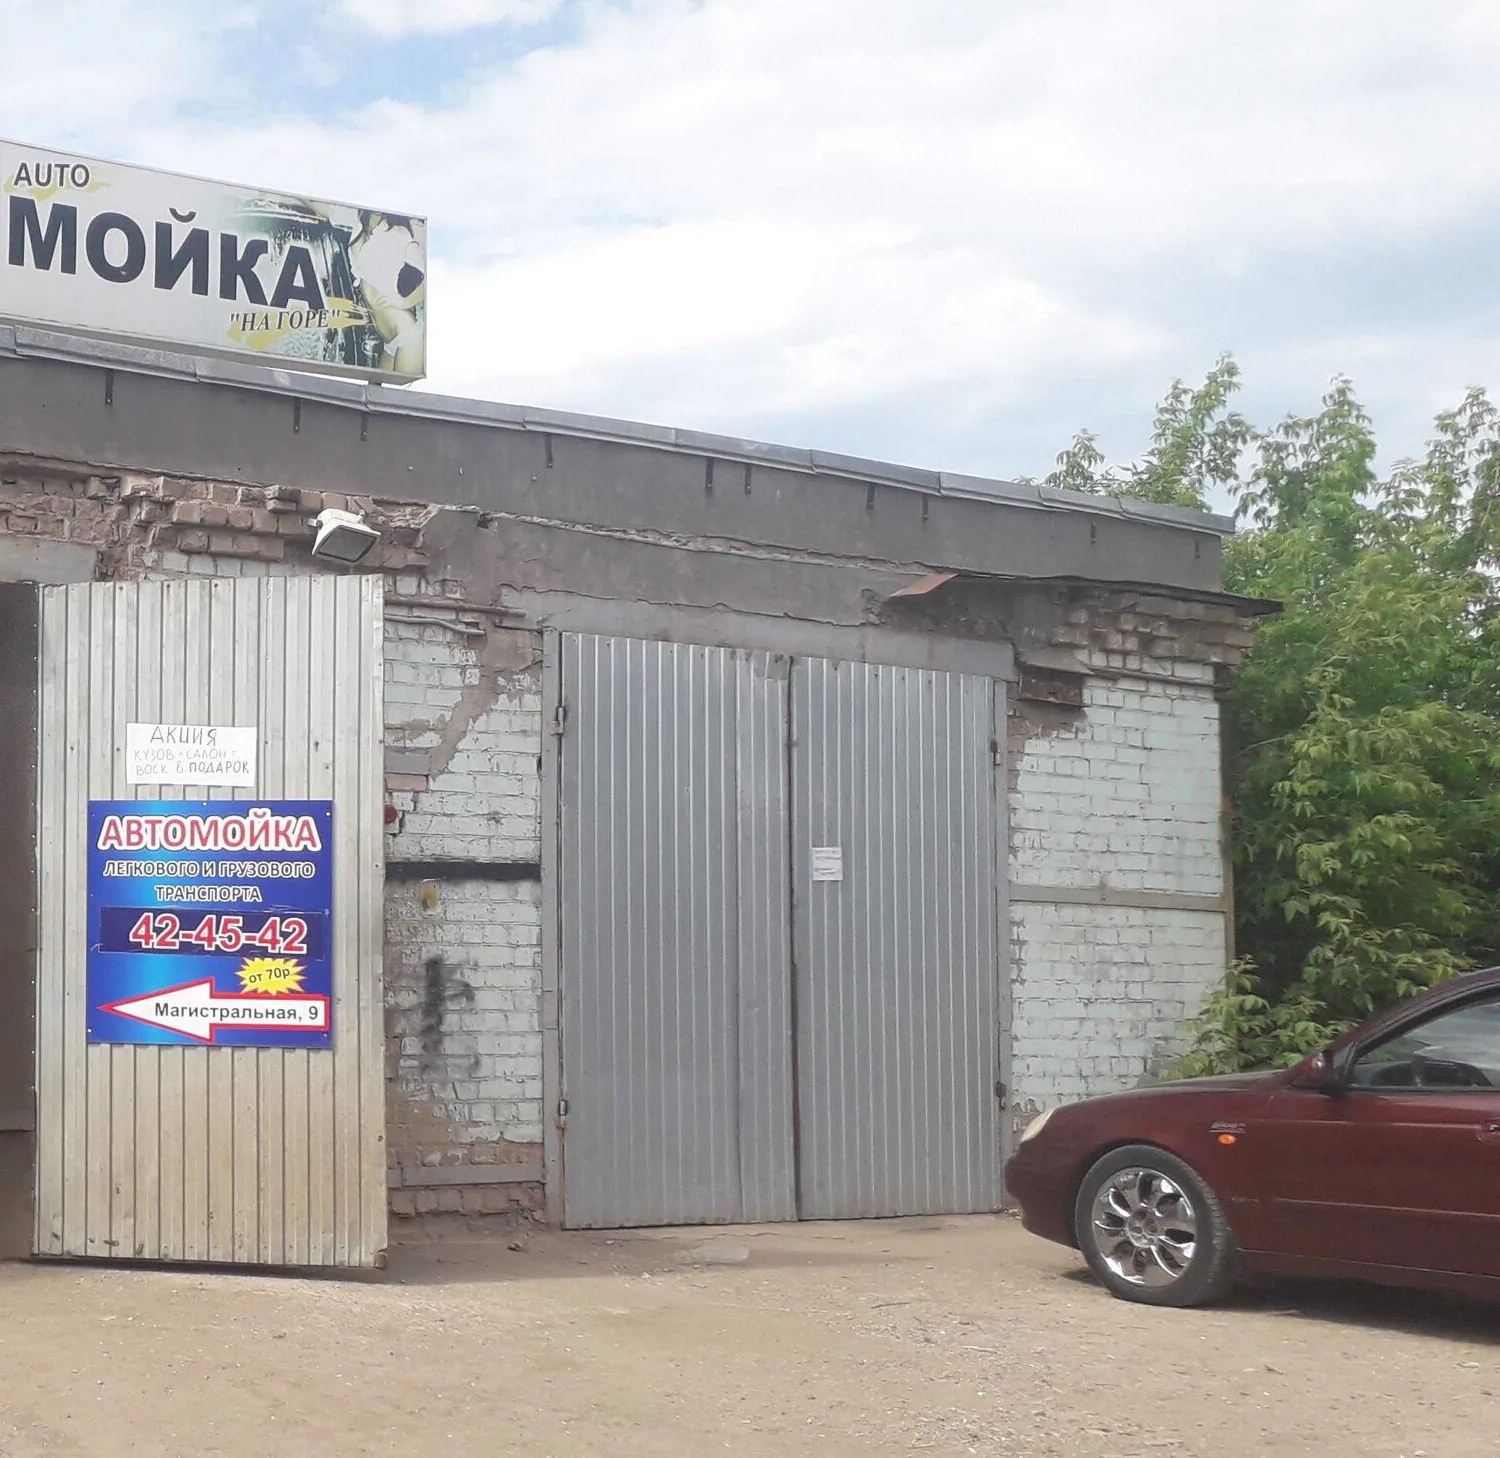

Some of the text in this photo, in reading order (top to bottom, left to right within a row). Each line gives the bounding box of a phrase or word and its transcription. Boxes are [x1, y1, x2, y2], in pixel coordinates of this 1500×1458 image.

[13, 162, 90, 188] AUTO
[7, 194, 325, 310] МОЙКА
[230, 308, 341, 332] "НА ГОРЕ"
[150, 726, 217, 746] АКЦИЯ
[189, 760, 250, 774] ПОДАРОК
[99, 808, 321, 850] АВТОМОЙКА
[103, 860, 315, 878] ЛЕГКОВОГО И ГРУЗОВОГО
[156, 886, 262, 902] ТРАНСПОРТА
[130, 913, 307, 953] 42-45-42
[249, 967, 290, 983] от 70р
[155, 1003, 318, 1022] Магистральная, 9
